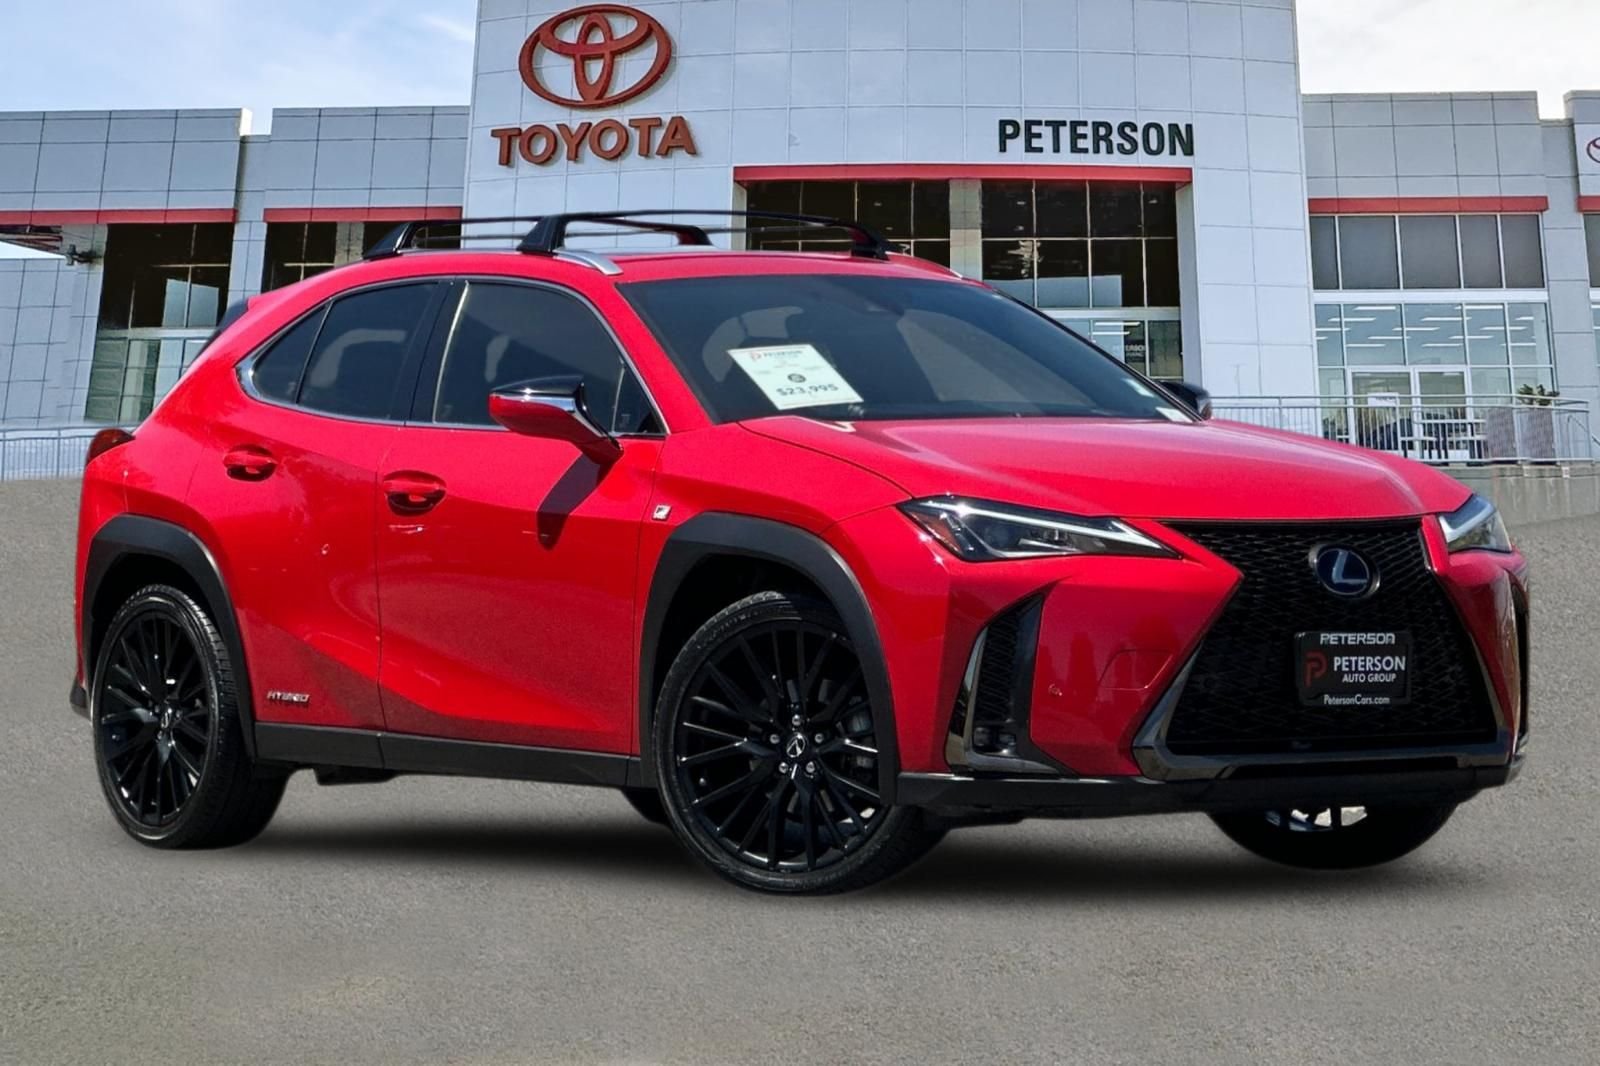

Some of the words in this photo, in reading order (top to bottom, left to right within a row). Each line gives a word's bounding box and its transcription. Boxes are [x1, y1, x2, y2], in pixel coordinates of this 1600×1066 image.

[491, 115, 697, 166] TOYOTA
[998, 119, 1195, 156] PETERSON
[776, 383, 838, 396] $23,995
[1319, 632, 1396, 645] PETERSON
[1333, 655, 1406, 672] PETERSON
[1342, 673, 1366, 683] AUTO
[1367, 673, 1397, 683] GROUP
[1323, 693, 1391, 705] PetersonCars.com
